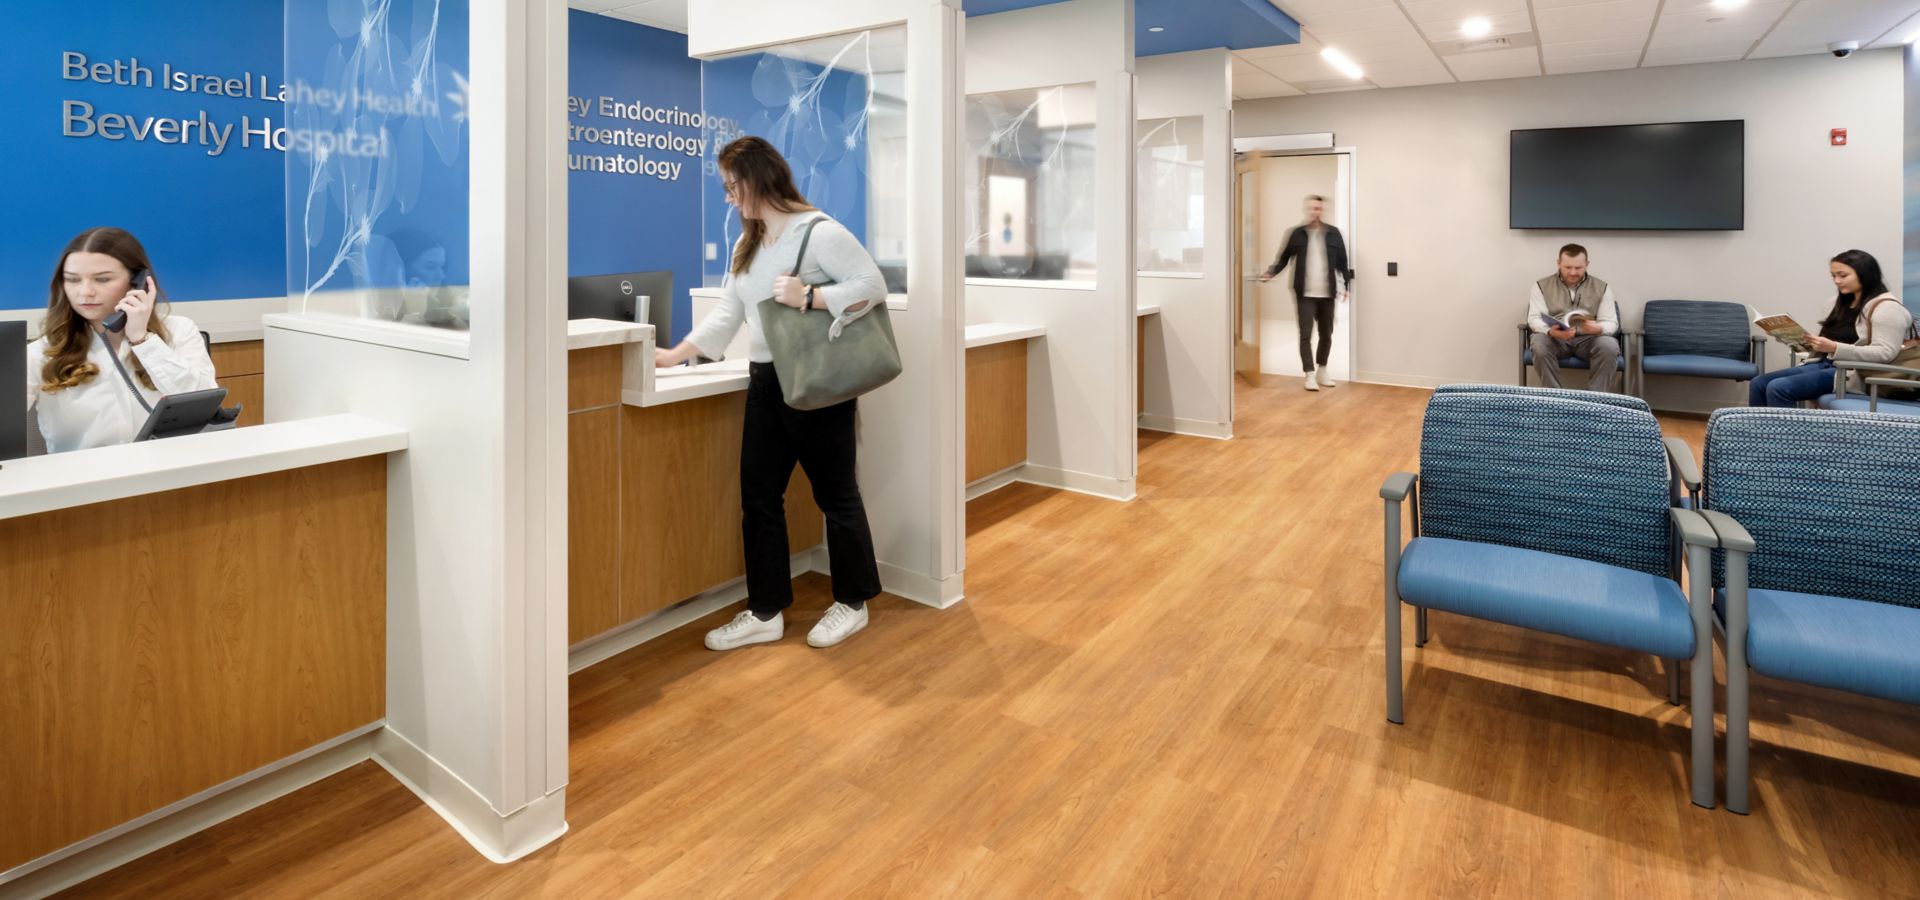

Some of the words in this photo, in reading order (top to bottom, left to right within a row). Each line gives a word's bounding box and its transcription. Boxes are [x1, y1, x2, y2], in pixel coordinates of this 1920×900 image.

[62, 51, 153, 88] Beth
[163, 63, 253, 98] Israel
[260, 75, 347, 116] Lahey
[352, 86, 438, 117] Health
[599, 96, 740, 134] Endocrinology
[62, 99, 234, 156] Beverly
[242, 115, 388, 161] Hospital
